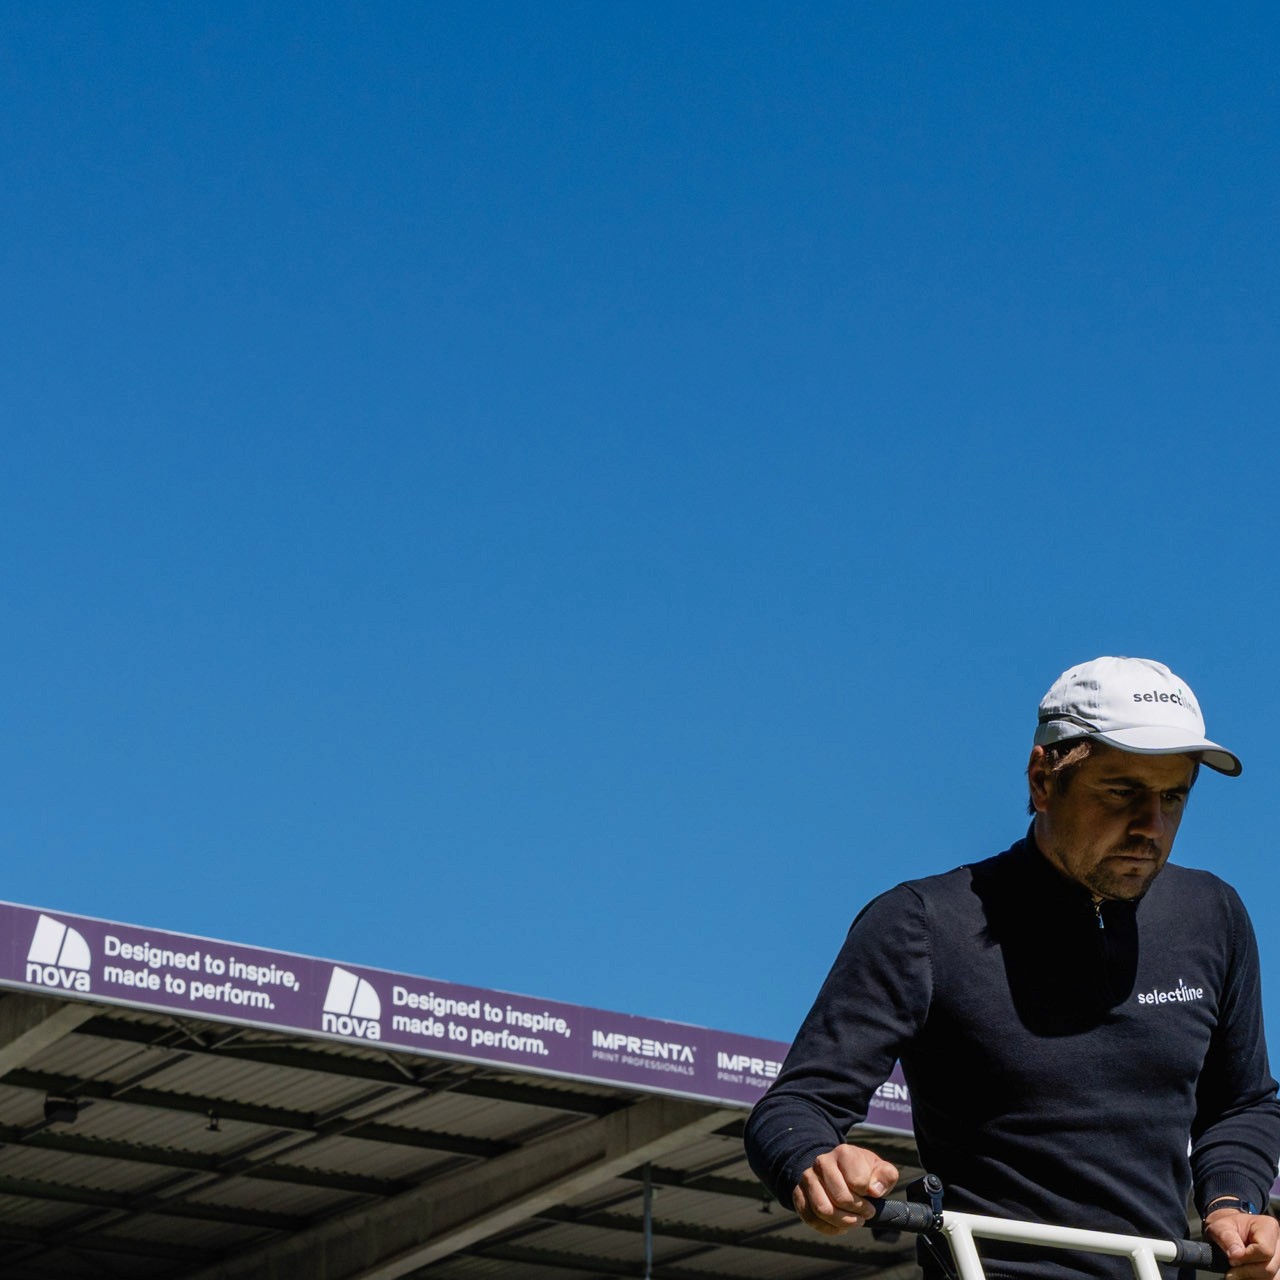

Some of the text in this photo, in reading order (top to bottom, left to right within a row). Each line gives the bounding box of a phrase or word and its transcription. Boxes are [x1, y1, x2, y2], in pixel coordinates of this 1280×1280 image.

[25, 961, 91, 993] nova
[104, 934, 300, 992] Designed to inspire,
[103, 965, 276, 1011] made to perform.
[1137, 978, 1204, 1005] selectline
[322, 1011, 381, 1041] nova
[392, 985, 571, 1038] Designed to inspire,
[392, 1014, 550, 1056] made to perform.
[592, 1029, 695, 1064] IMPRENTA
[592, 1050, 695, 1077] PRINT PROFESSIONALS
[717, 1071, 744, 1085] PRINT
